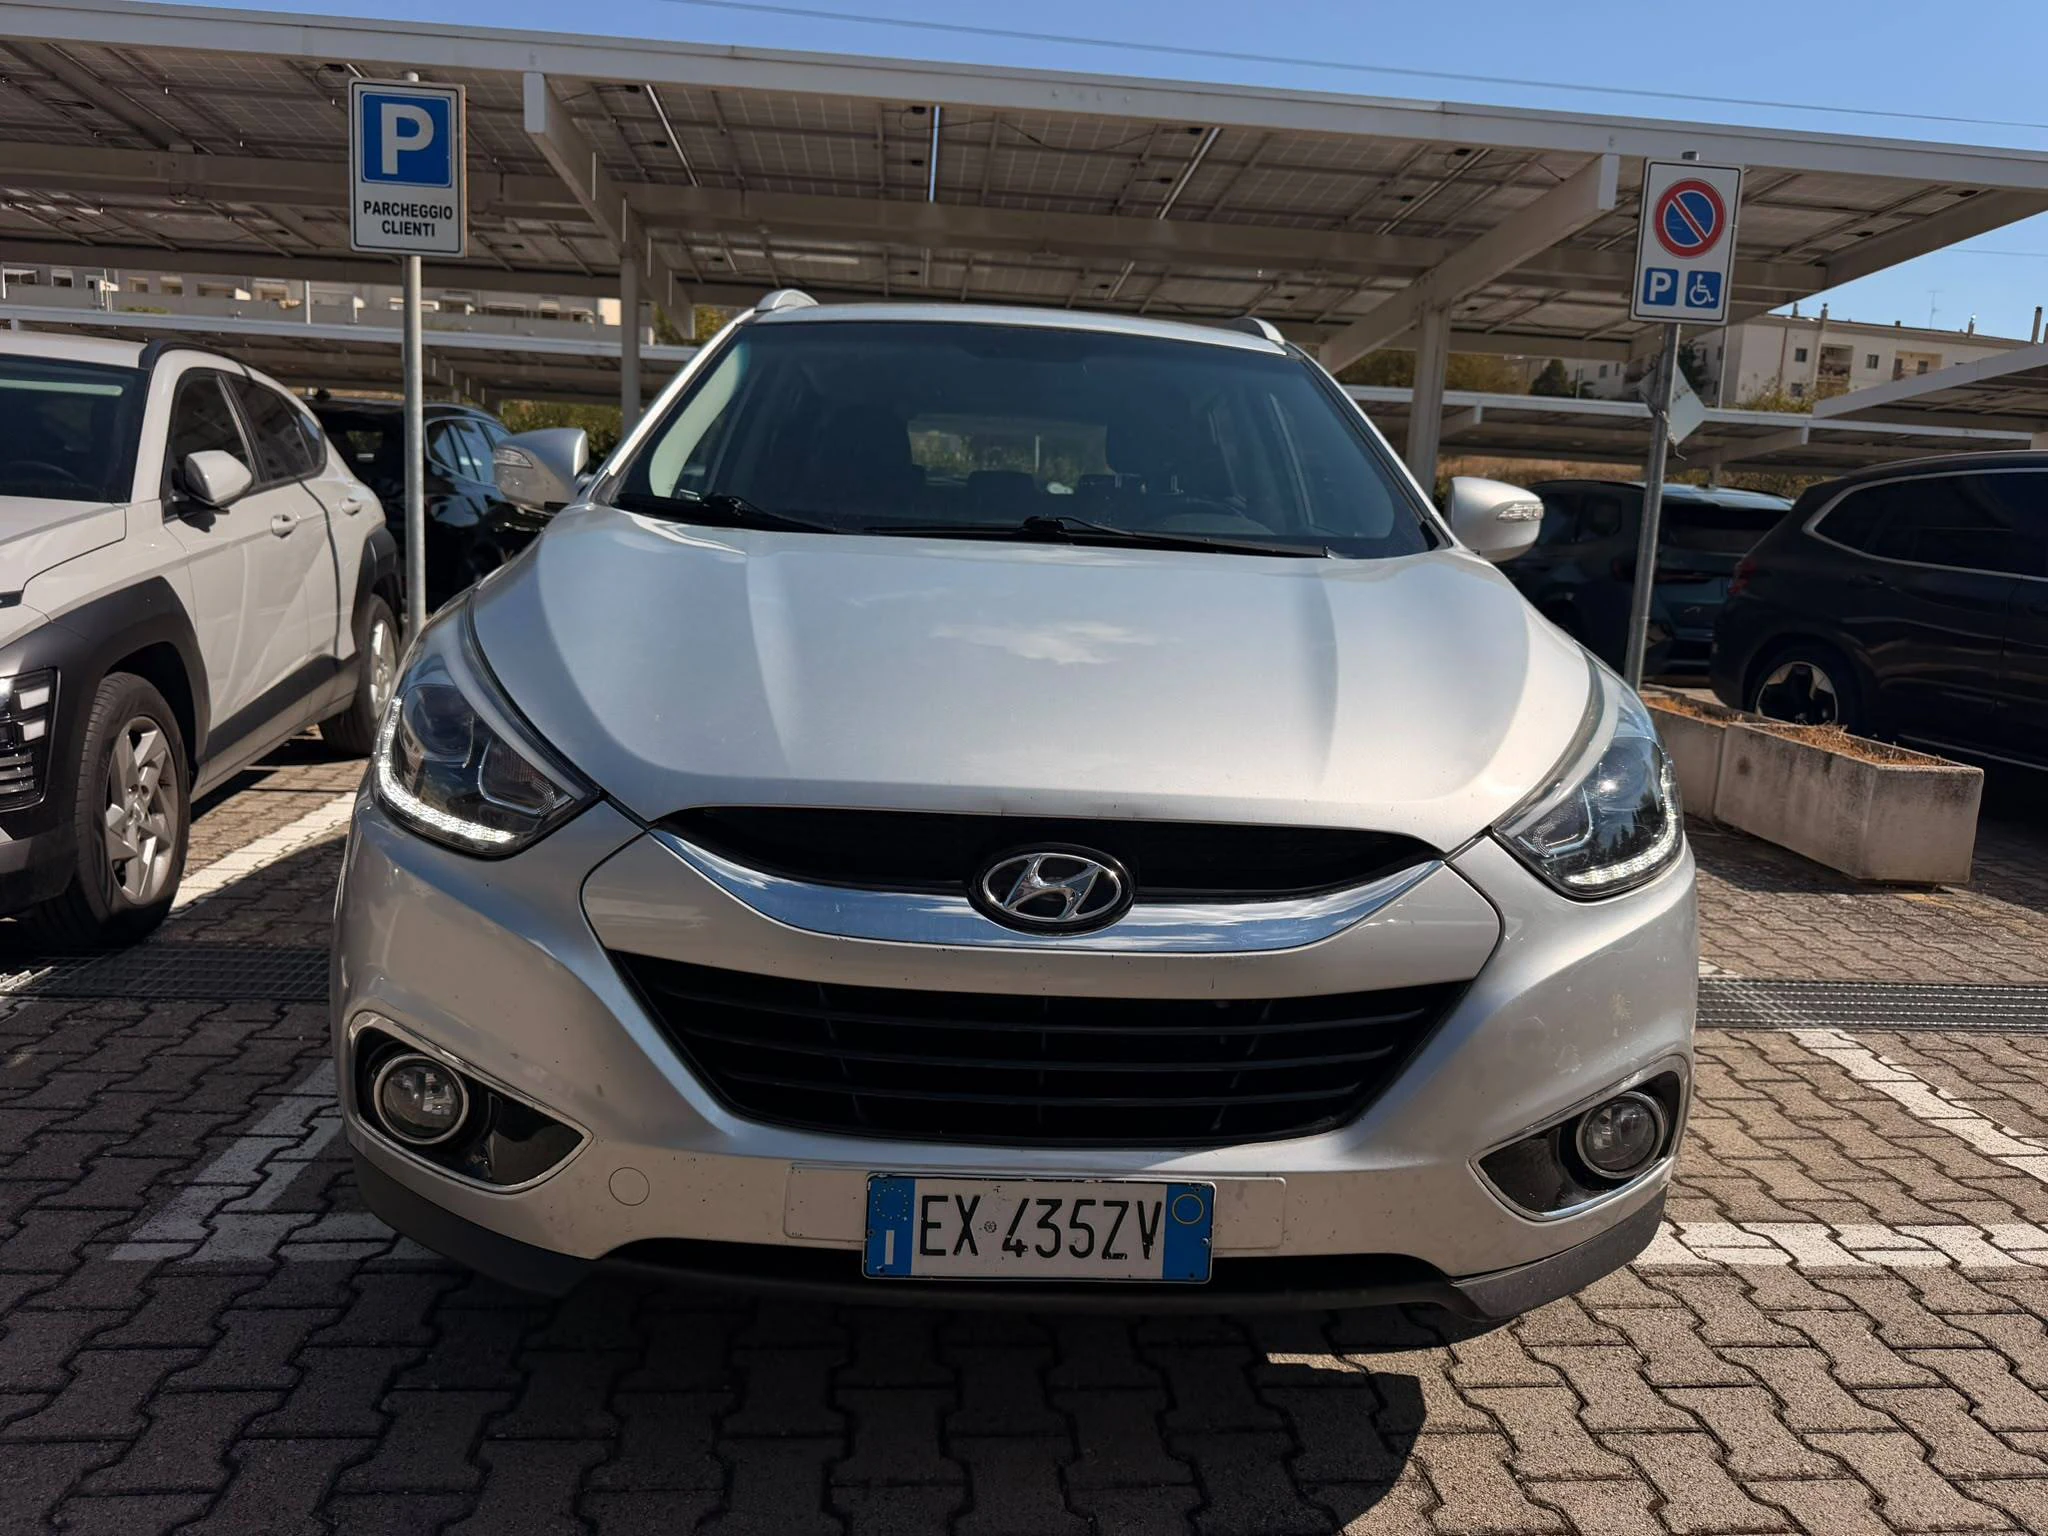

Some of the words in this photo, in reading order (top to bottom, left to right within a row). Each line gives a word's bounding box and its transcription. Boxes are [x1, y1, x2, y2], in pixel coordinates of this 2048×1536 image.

[381, 103, 434, 175] P
[363, 200, 453, 220] PARCHEGGIO
[381, 220, 436, 237] CLIENTI
[1649, 272, 1672, 302] P
[920, 1194, 981, 1257] EX
[1001, 1197, 1162, 1261] 435ZV
